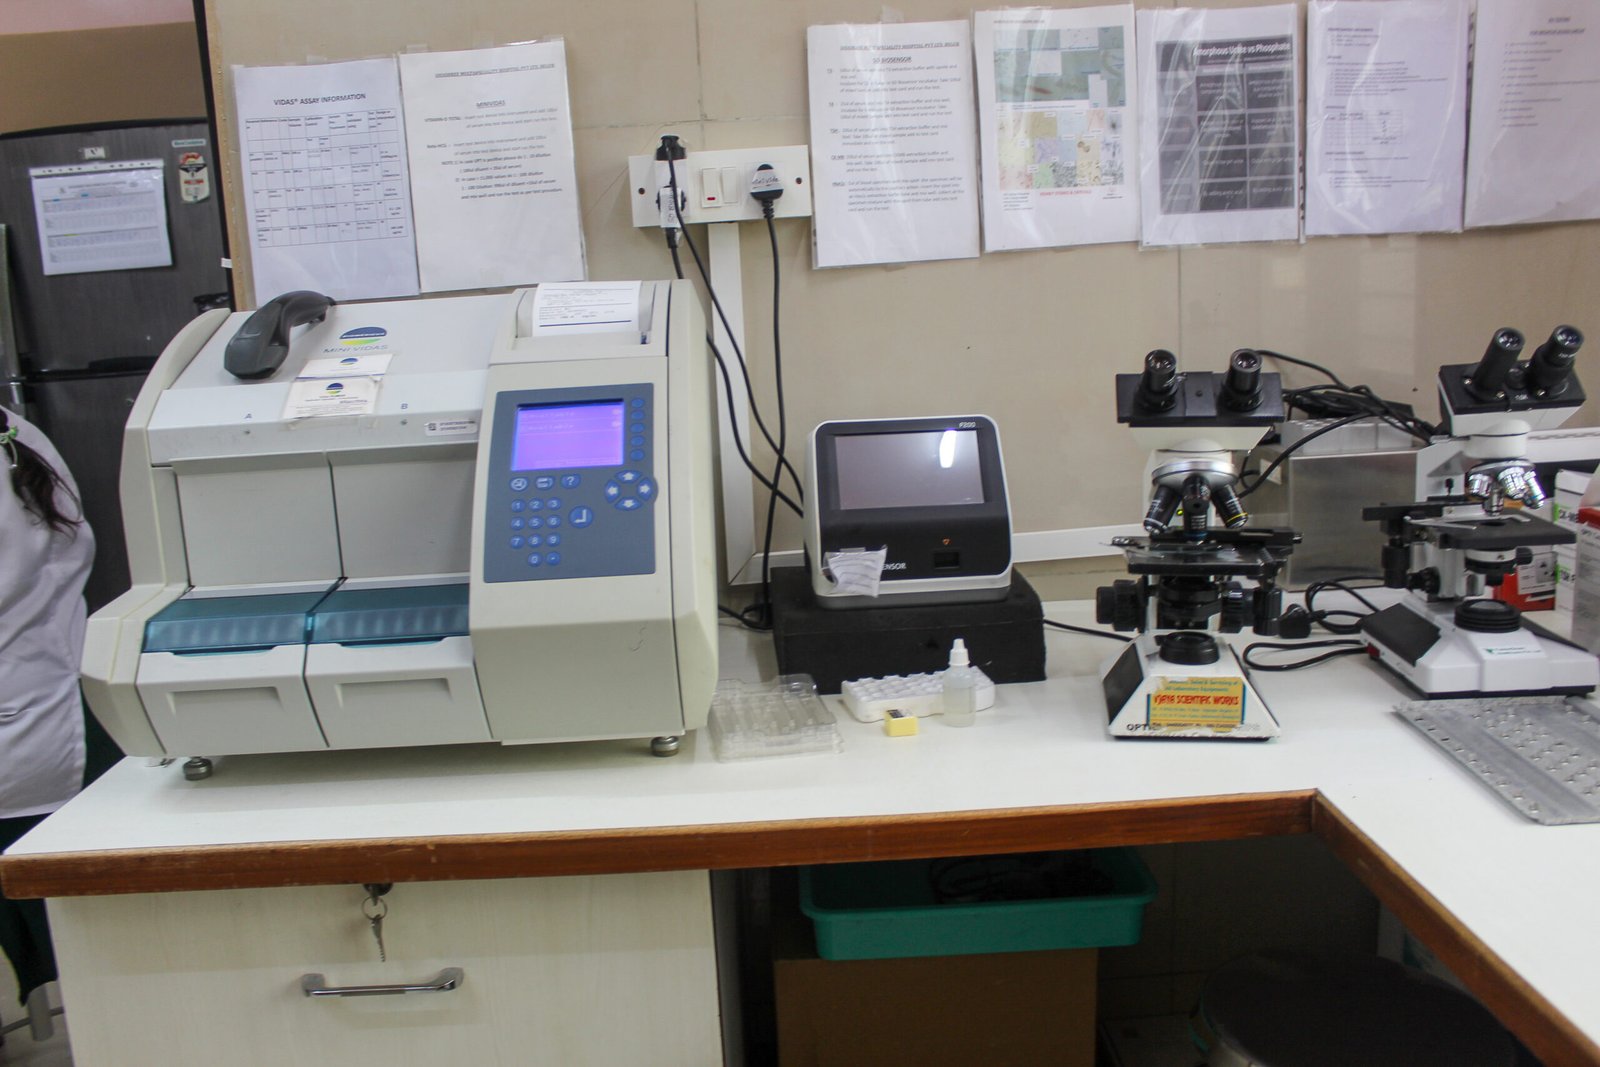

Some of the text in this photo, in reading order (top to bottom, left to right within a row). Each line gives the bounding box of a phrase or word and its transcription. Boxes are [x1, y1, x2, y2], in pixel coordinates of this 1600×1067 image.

[1193, 45, 1227, 58] Amorphous
[1256, 41, 1291, 56] Phosphate
[299, 97, 321, 105] ASSAY
[321, 93, 367, 104] INFORMATION
[353, 344, 389, 352] VIDAS
[567, 476, 575, 486] ?
[1176, 695, 1212, 705] SCIENTIFIC
[1213, 696, 1240, 706] WORKS
